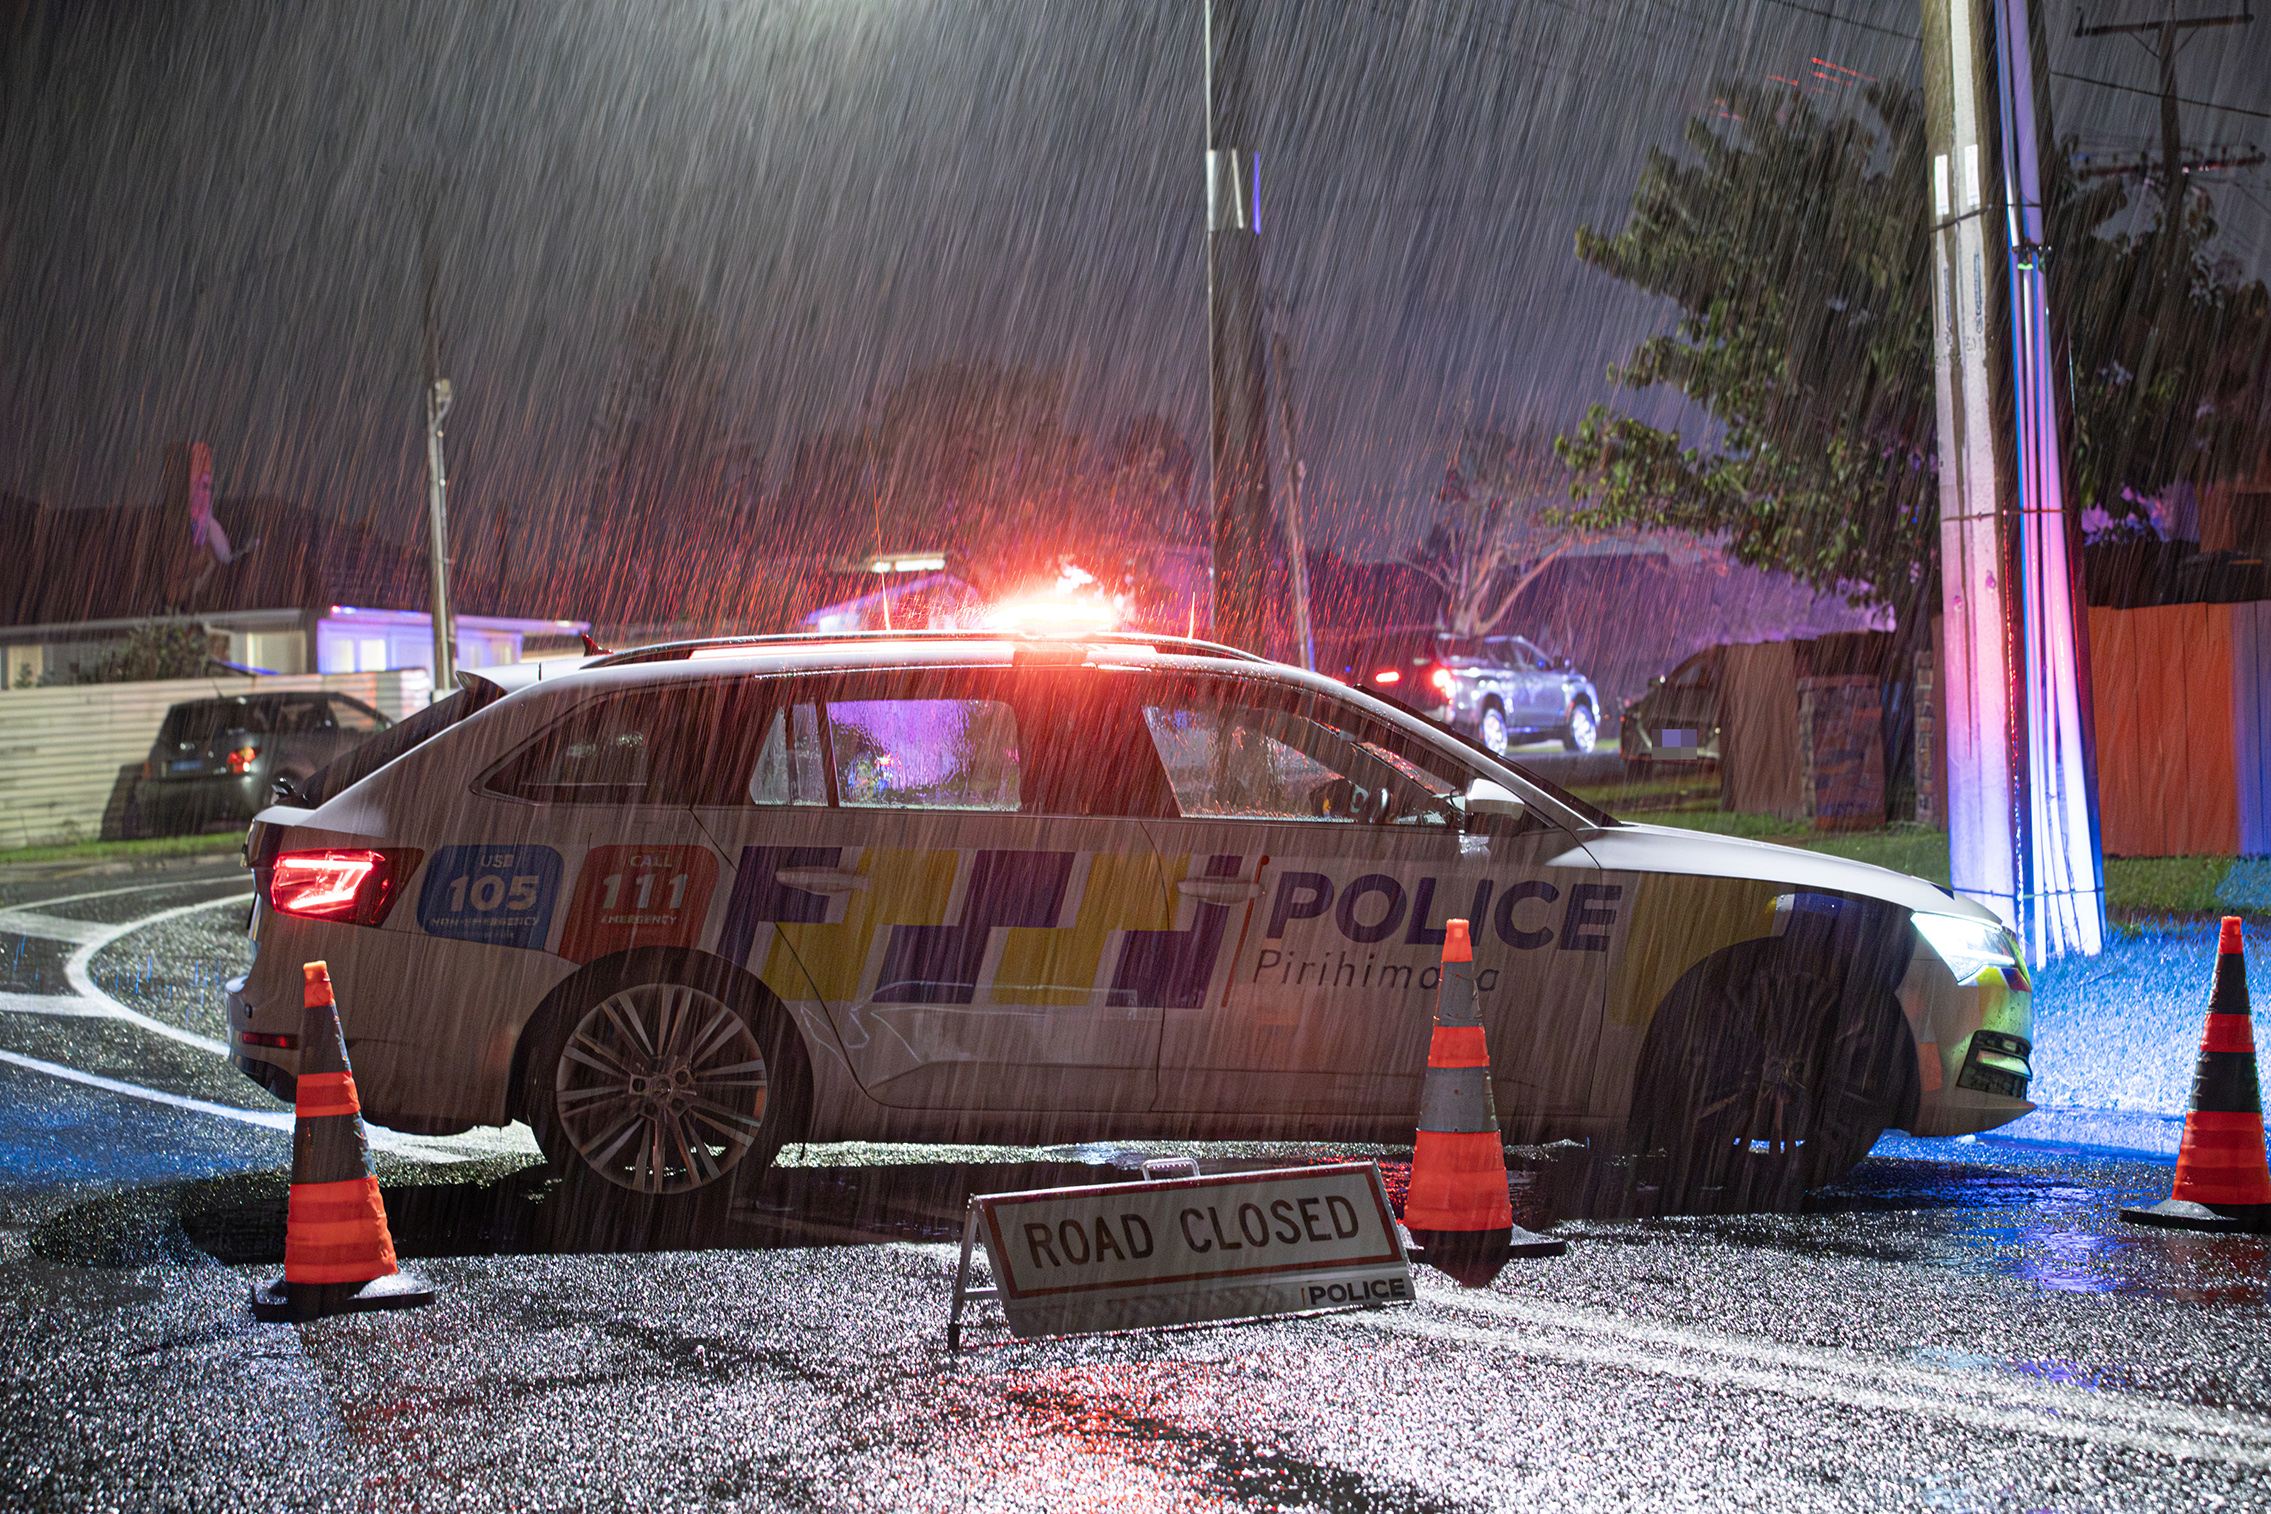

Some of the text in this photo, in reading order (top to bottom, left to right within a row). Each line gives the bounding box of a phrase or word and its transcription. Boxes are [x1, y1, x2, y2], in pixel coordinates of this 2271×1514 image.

[480, 854, 515, 868] USE
[630, 855, 673, 868] CALL
[449, 874, 540, 913] 105
[603, 873, 689, 910] 111
[1266, 871, 1623, 952] POLICE
[1252, 948, 1500, 992] Pirihimaa
[1025, 1195, 1359, 1268] ROAD CLOSED
[1309, 1278, 1406, 1306] POLICE
